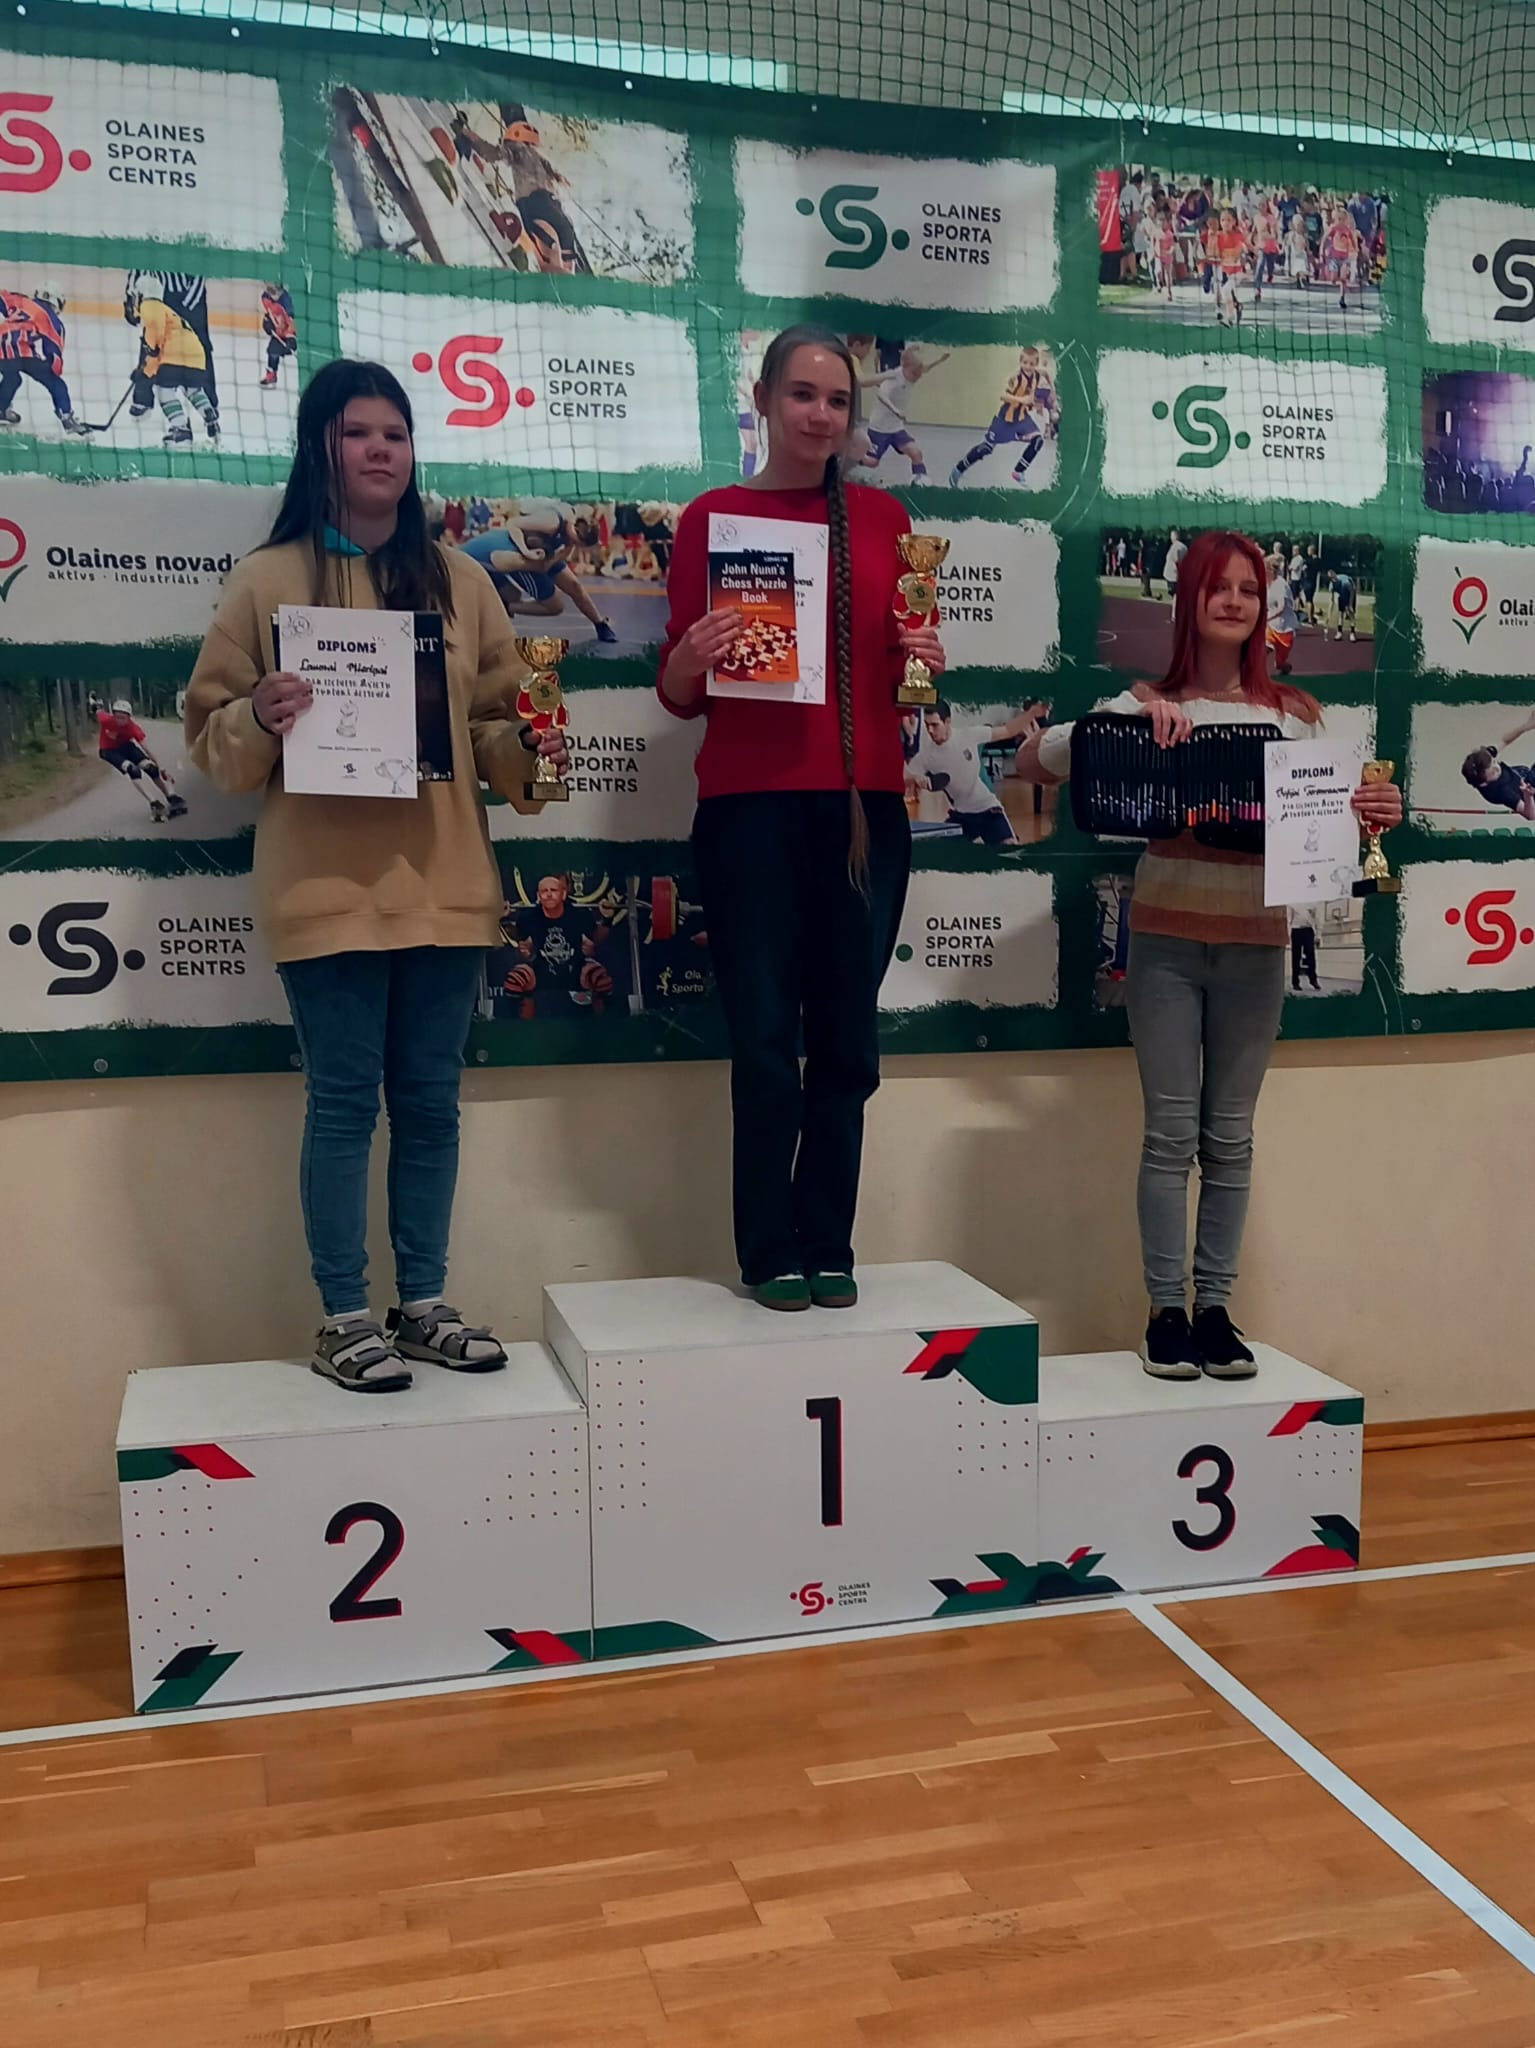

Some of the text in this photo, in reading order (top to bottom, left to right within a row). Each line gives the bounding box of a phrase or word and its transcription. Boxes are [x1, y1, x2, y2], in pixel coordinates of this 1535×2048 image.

[106, 120, 205, 143] OLAINES
[107, 143, 197, 165] SPORTA
[109, 166, 196, 188] CENTRS
[922, 203, 1001, 222] OLAINES
[922, 223, 992, 243] SPORTA
[921, 244, 990, 265] CENTRS
[548, 358, 635, 376] OLAINES
[549, 380, 628, 397] SPORTA
[549, 402, 627, 418] CENTRS
[1262, 405, 1334, 421] OLAINES
[1262, 424, 1326, 440] SPORTA
[1262, 444, 1325, 460] CENTRS
[46, 546, 147, 570] Olaines
[722, 562, 785, 575] John Nunn's
[721, 576, 752, 589] Chess
[755, 577, 787, 589] Puzzle
[742, 592, 768, 603] Book
[936, 586, 995, 602] PORTA
[940, 606, 993, 622] ENTRS
[1500, 599, 1535, 615] Olai
[317, 640, 376, 653] DIPLOMS
[1291, 766, 1334, 779] DIPLOMS
[158, 917, 254, 933] OLAINES
[926, 916, 1002, 930] OLAINES
[160, 938, 246, 954] SPORTA
[926, 935, 994, 949] SPORTA
[162, 960, 245, 976] CENTRS
[925, 954, 993, 967] CENTRS
[806, 1396, 843, 1527] 1
[1172, 1444, 1236, 1551] 3
[325, 1501, 405, 1623] 2
